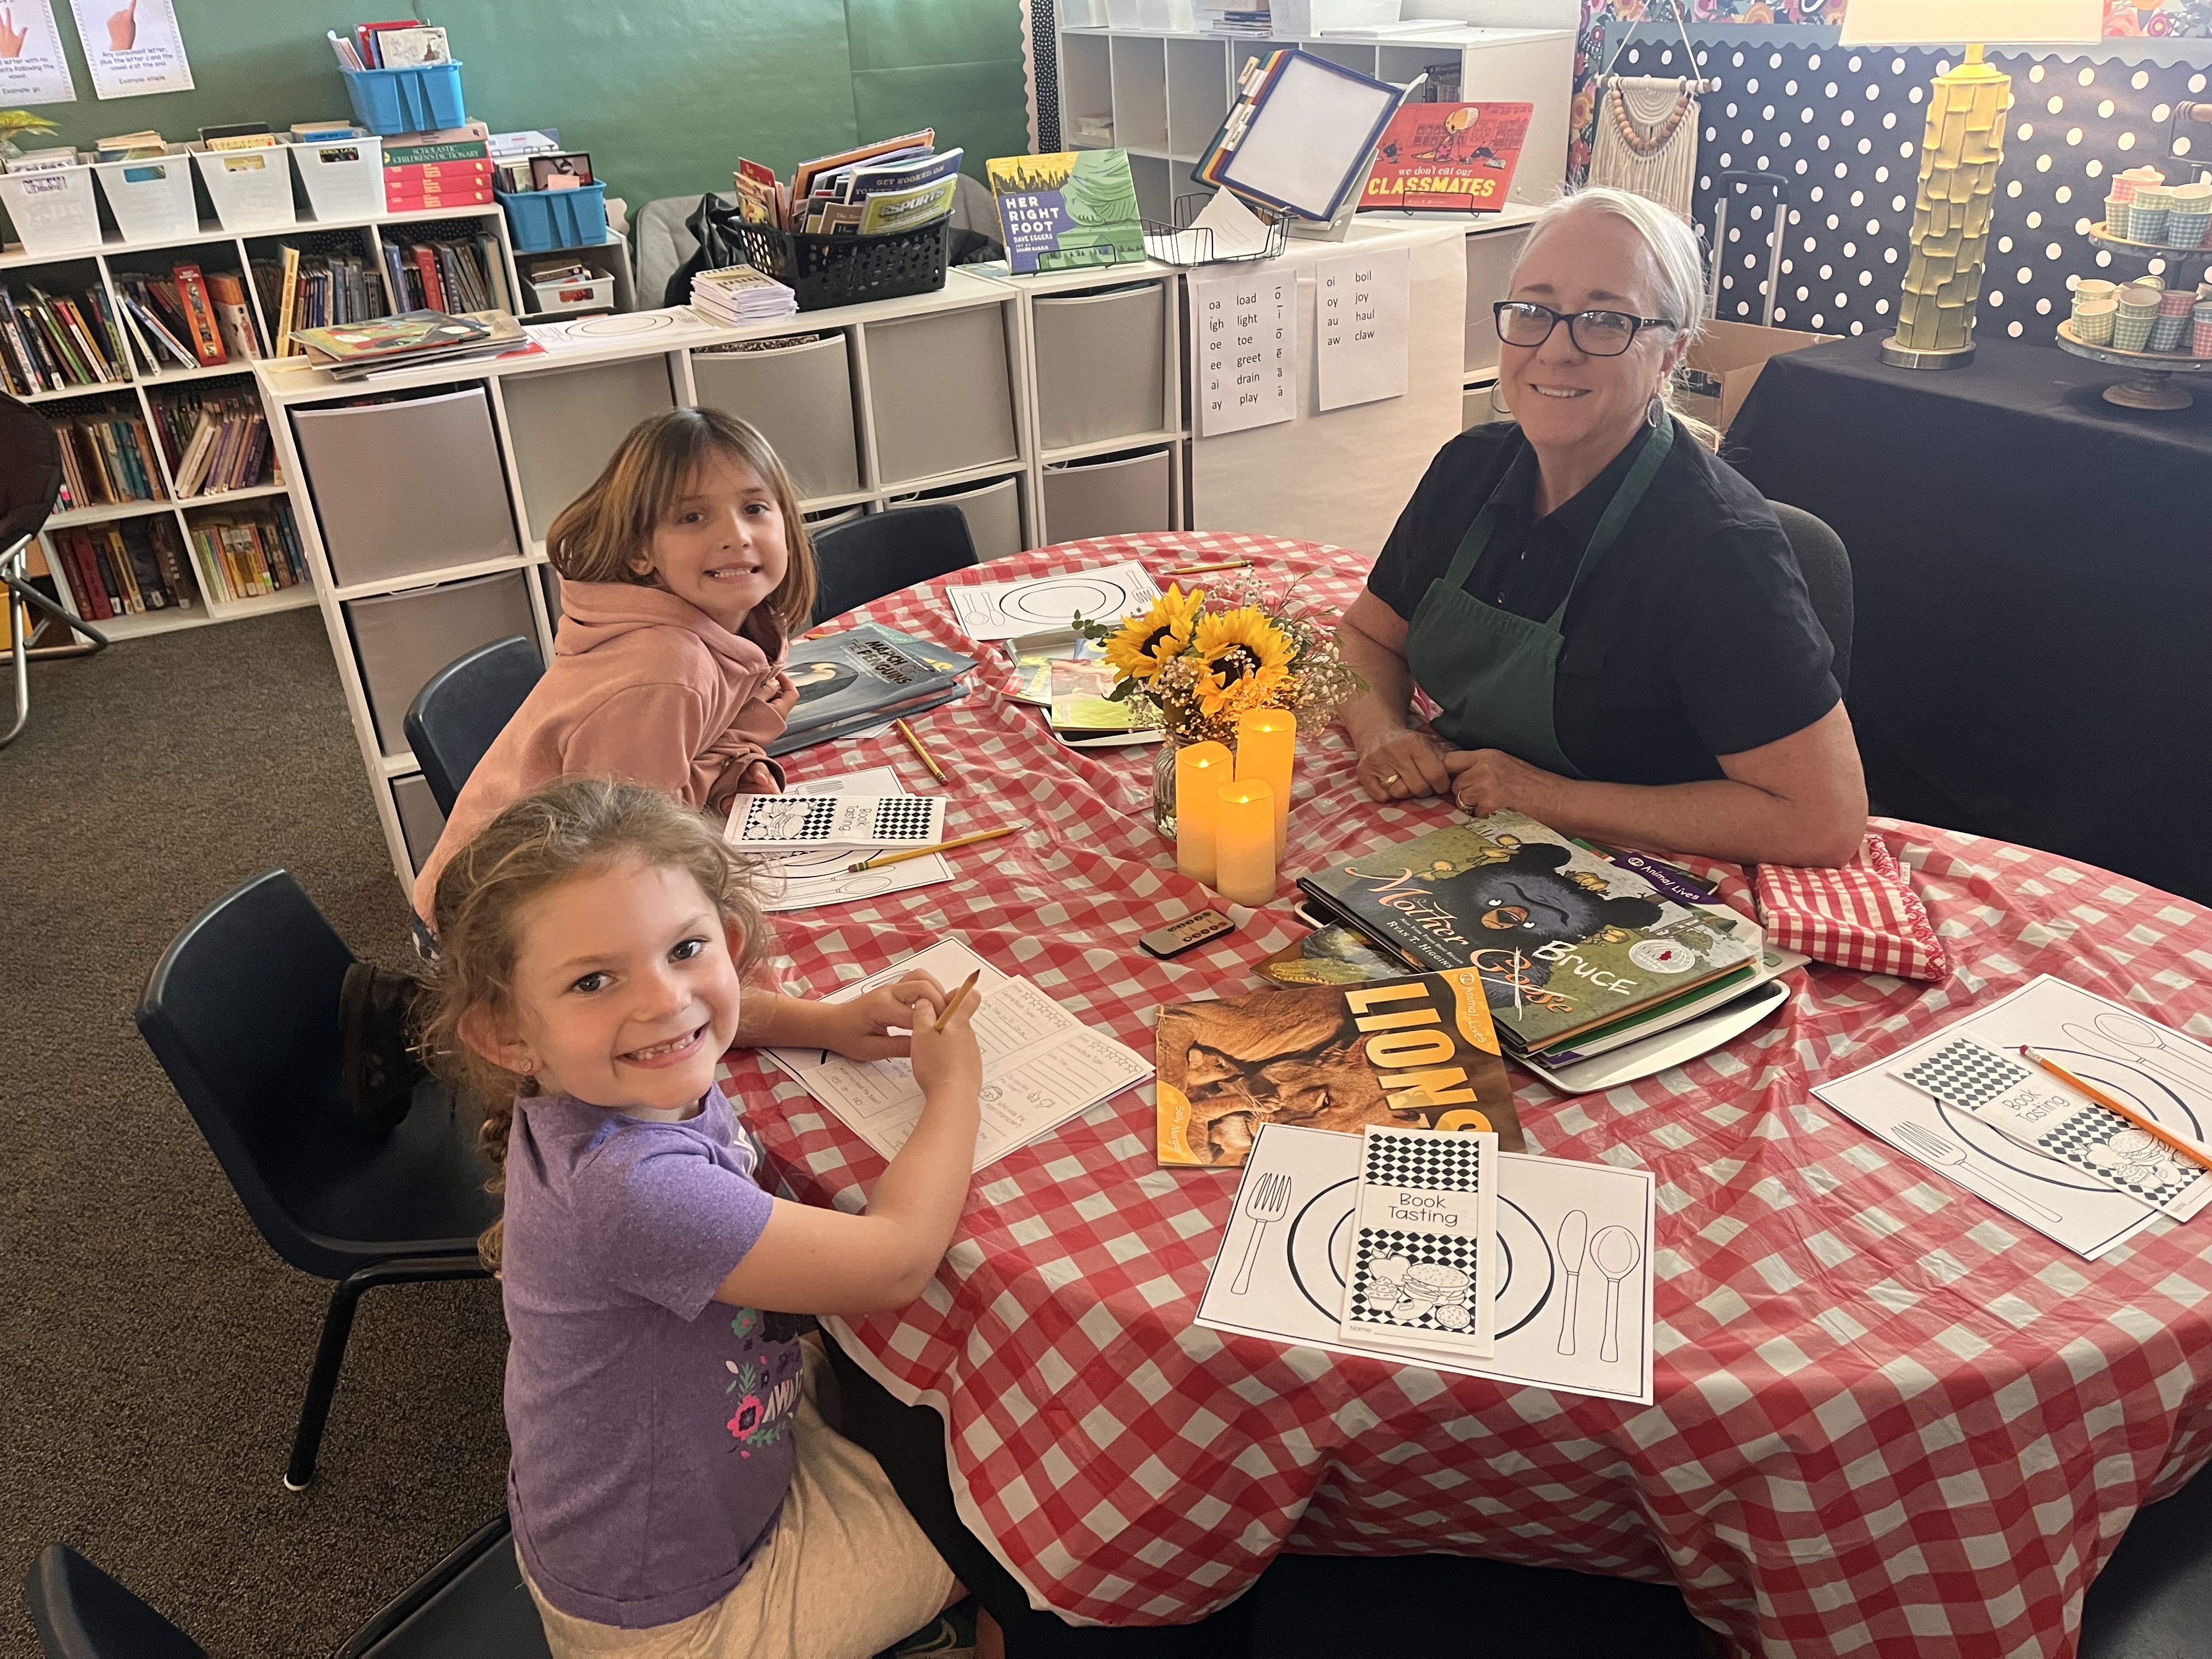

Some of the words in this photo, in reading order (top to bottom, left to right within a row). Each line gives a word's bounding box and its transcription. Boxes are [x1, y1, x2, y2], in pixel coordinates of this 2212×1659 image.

[412, 145, 457, 155] SCHOLASTIC
[435, 149, 478, 161] DICTIONARY
[933, 165, 945, 174] ON
[1414, 165, 1436, 176] don't
[1438, 166, 1455, 176] eat
[1368, 176, 1497, 197] CLASSMATES
[1006, 196, 1039, 209] HER
[1009, 207, 1059, 221] RIGHT
[1011, 221, 1053, 235] FOOT
[1013, 235, 1029, 243] DAVE
[1030, 233, 1053, 241] EGGERS
[1327, 276, 1335, 287] oi
[1355, 270, 1372, 282] boil
[1209, 301, 1221, 309] oa
[1237, 292, 1257, 306] load
[1327, 298, 1339, 308] oy
[1355, 292, 1369, 305] joy
[1210, 317, 1224, 332] igh
[1237, 313, 1258, 327] light
[1328, 318, 1339, 326] au
[1356, 308, 1375, 321] haul
[1210, 341, 1222, 350] oe
[1238, 336, 1253, 346] toe
[1328, 336, 1341, 346] aw
[1355, 330, 1375, 341] claw
[1211, 362, 1222, 370] ee
[1237, 353, 1261, 368] greet
[1211, 379, 1219, 390] ai
[1237, 373, 1260, 385] drain
[1212, 400, 1222, 410] ay
[1240, 393, 1259, 407] play
[843, 638, 867, 652] THE
[856, 650, 913, 685] PENGUINS
[865, 641, 909, 665] MARCH
[900, 664, 923, 675] OF
[838, 805, 855, 831] Tasting
[856, 807, 872, 827] Book
[1640, 865, 1677, 886] Animal
[1671, 885, 1700, 900] Lives
[1345, 867, 1469, 946] Mother
[1386, 921, 1410, 937] RYAN
[1409, 936, 1421, 945] T.
[1418, 944, 1454, 969] HIGGINS
[1470, 948, 1573, 1013] Goose
[1462, 987, 1480, 1017] Animal
[1468, 1020, 1487, 1043] Lives
[2001, 1087, 2042, 1111] Book
[1172, 1106, 1184, 1124] Sally
[2015, 1094, 2071, 1123] Tasting
[1168, 1125, 1182, 1153] Morgan
[1400, 1193, 1446, 1209] Book
[1388, 1205, 1459, 1227] Tasting
[1350, 1325, 1372, 1334] Name
